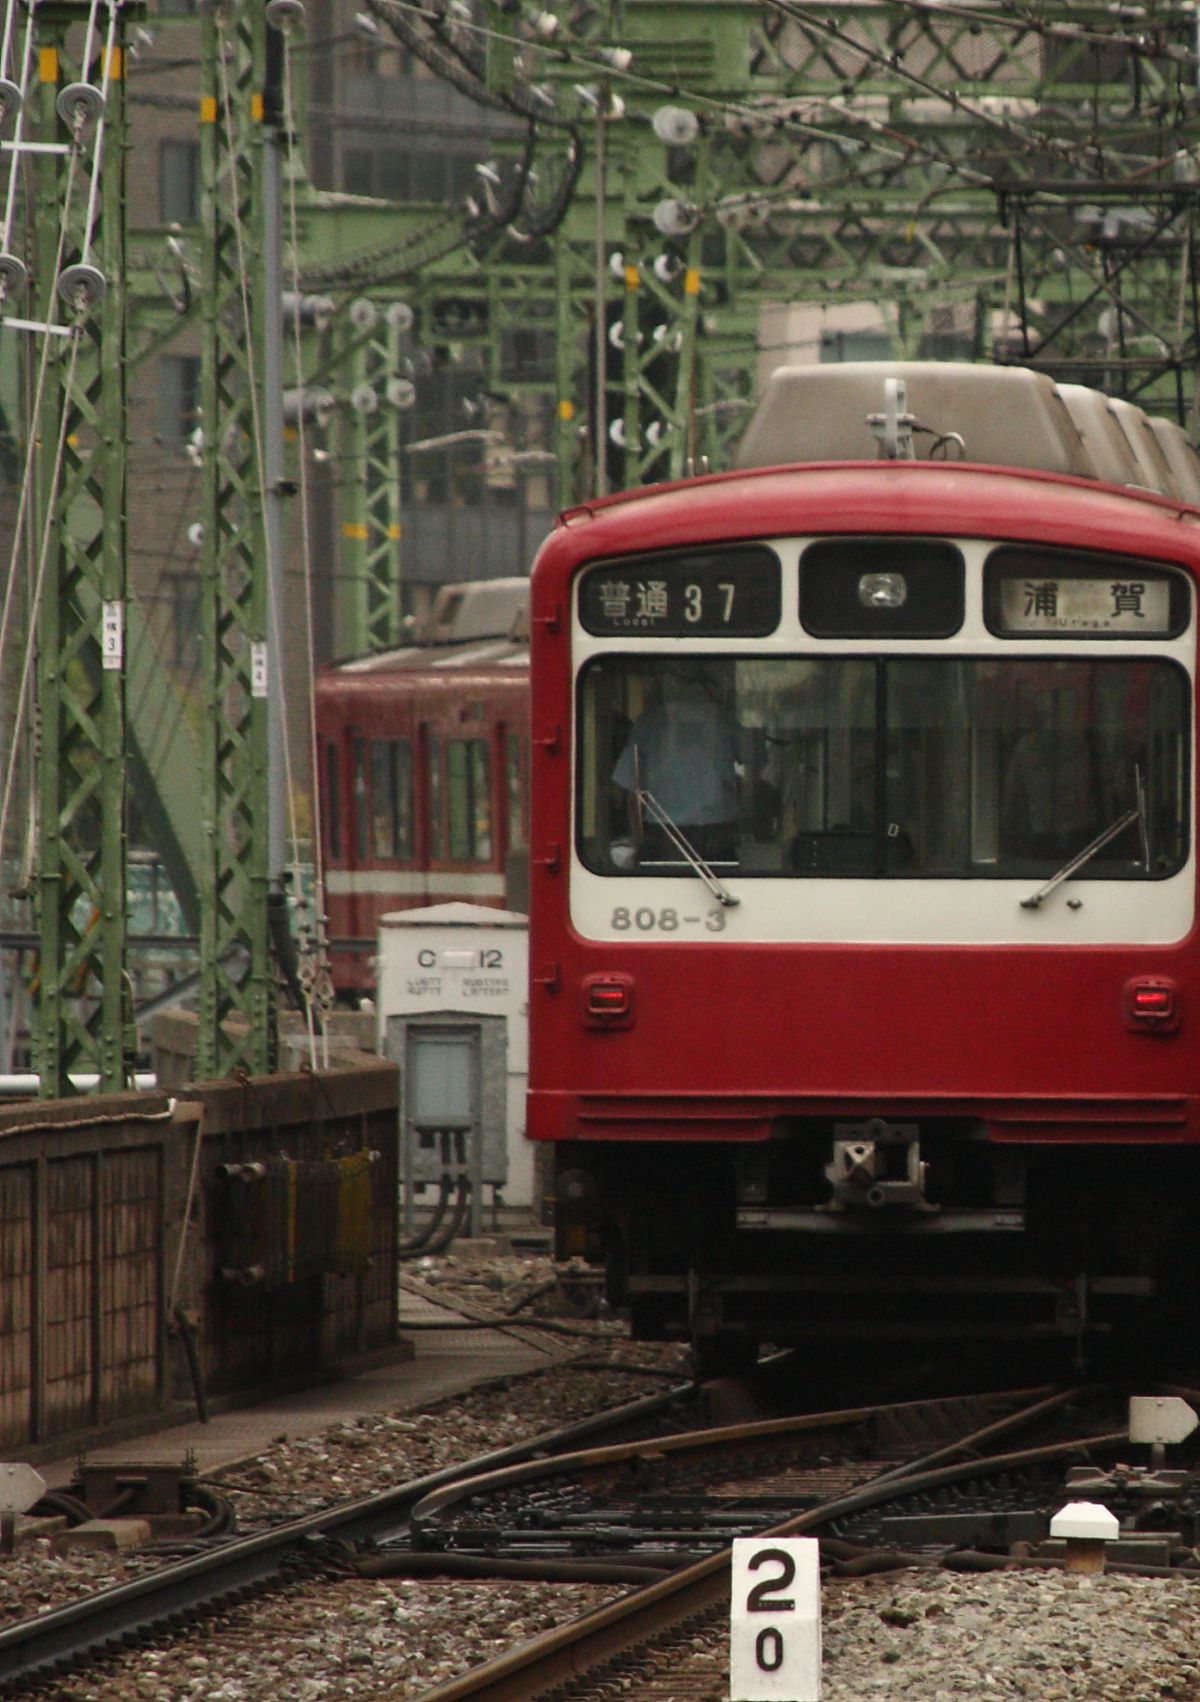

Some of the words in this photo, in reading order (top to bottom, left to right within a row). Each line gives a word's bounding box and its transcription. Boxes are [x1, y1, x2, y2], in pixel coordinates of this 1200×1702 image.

[600, 580, 668, 617] 普通
[684, 584, 735, 622] 37
[1024, 582, 1145, 618] 浦賀
[613, 617, 655, 626] Local
[610, 906, 727, 932] 808-3
[418, 949, 436, 968] C
[480, 949, 502, 969] 12
[747, 1548, 796, 1612] 2
[756, 1627, 783, 1671] 0
